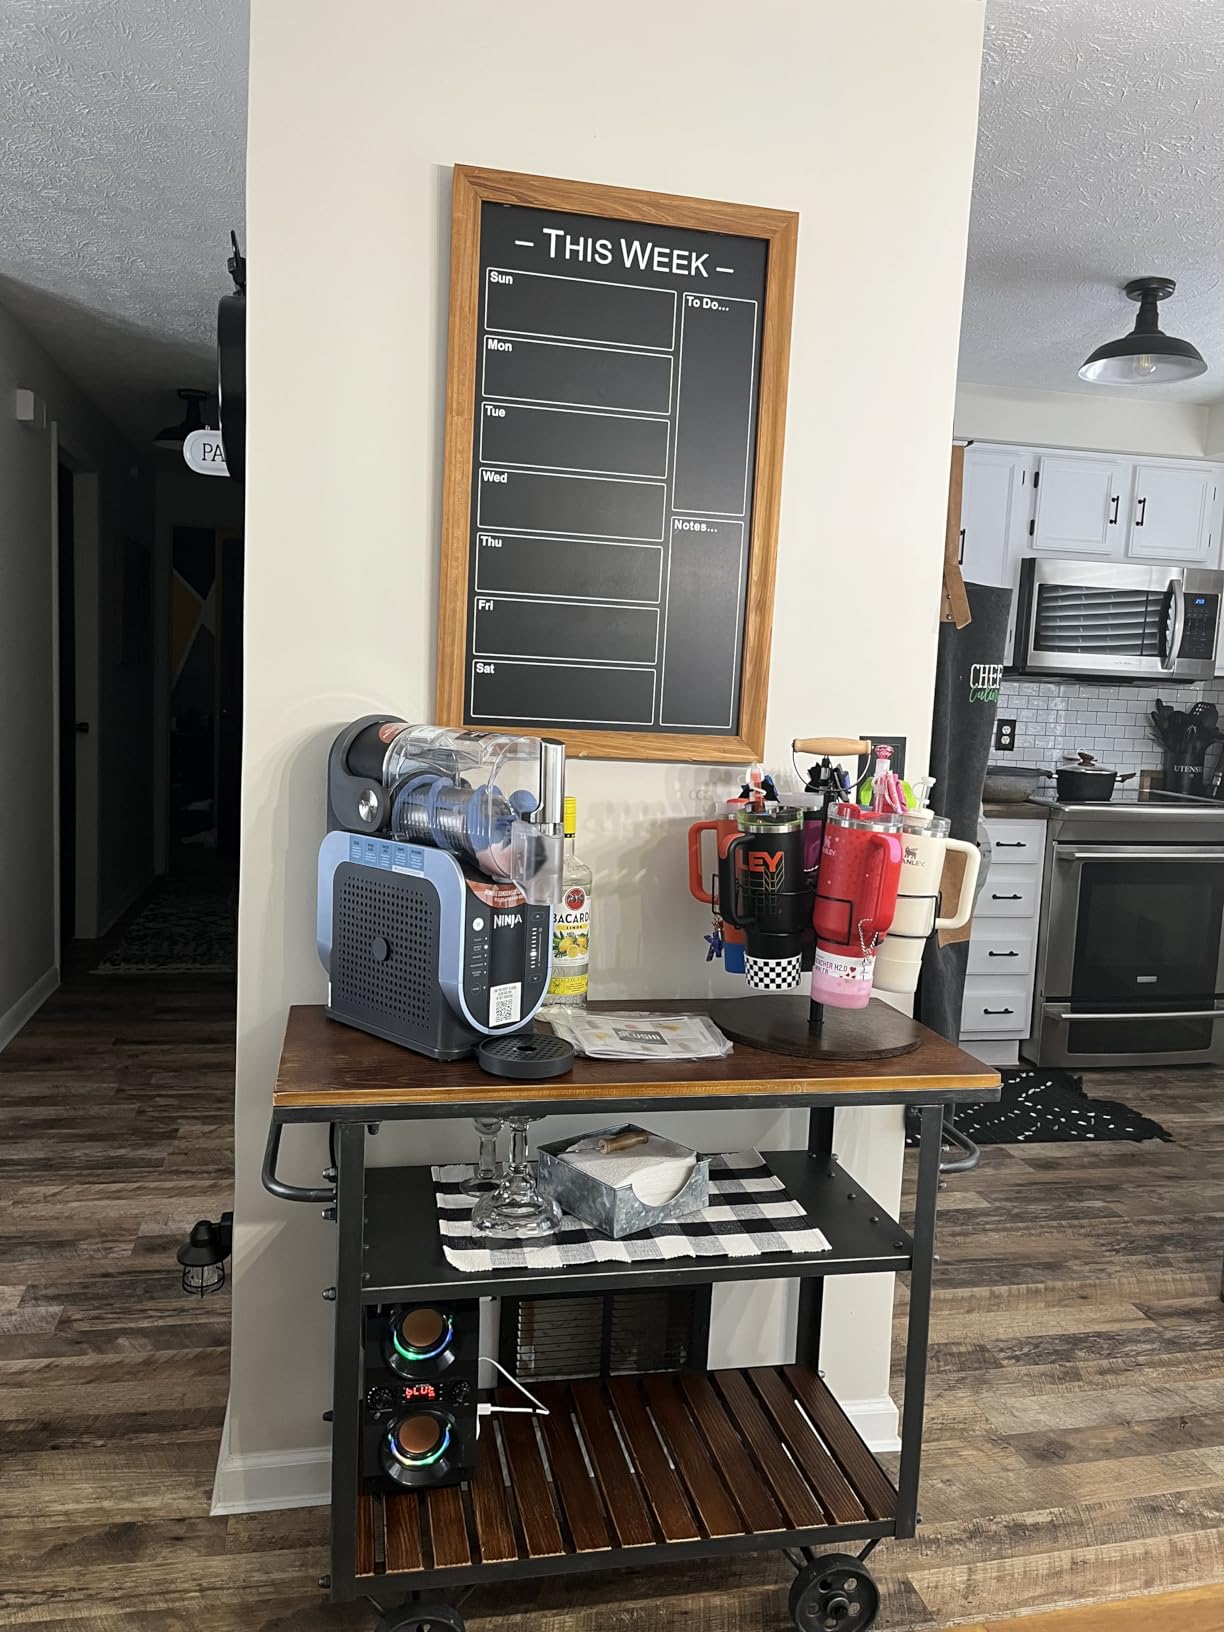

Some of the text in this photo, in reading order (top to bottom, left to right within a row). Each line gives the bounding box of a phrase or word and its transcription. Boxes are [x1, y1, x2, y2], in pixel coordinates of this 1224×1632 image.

[542, 227, 709, 278] THIS WEEK
[489, 271, 513, 284] Sun
[686, 296, 701, 308] To
[487, 339, 512, 352] Mon
[485, 405, 506, 417] Tue
[482, 471, 508, 483] Wed
[674, 520, 718, 533] Notes...
[480, 535, 502, 548] Thu
[478, 599, 494, 610] Fri
[476, 662, 495, 674] Sat
[493, 914, 523, 929] NINJA
